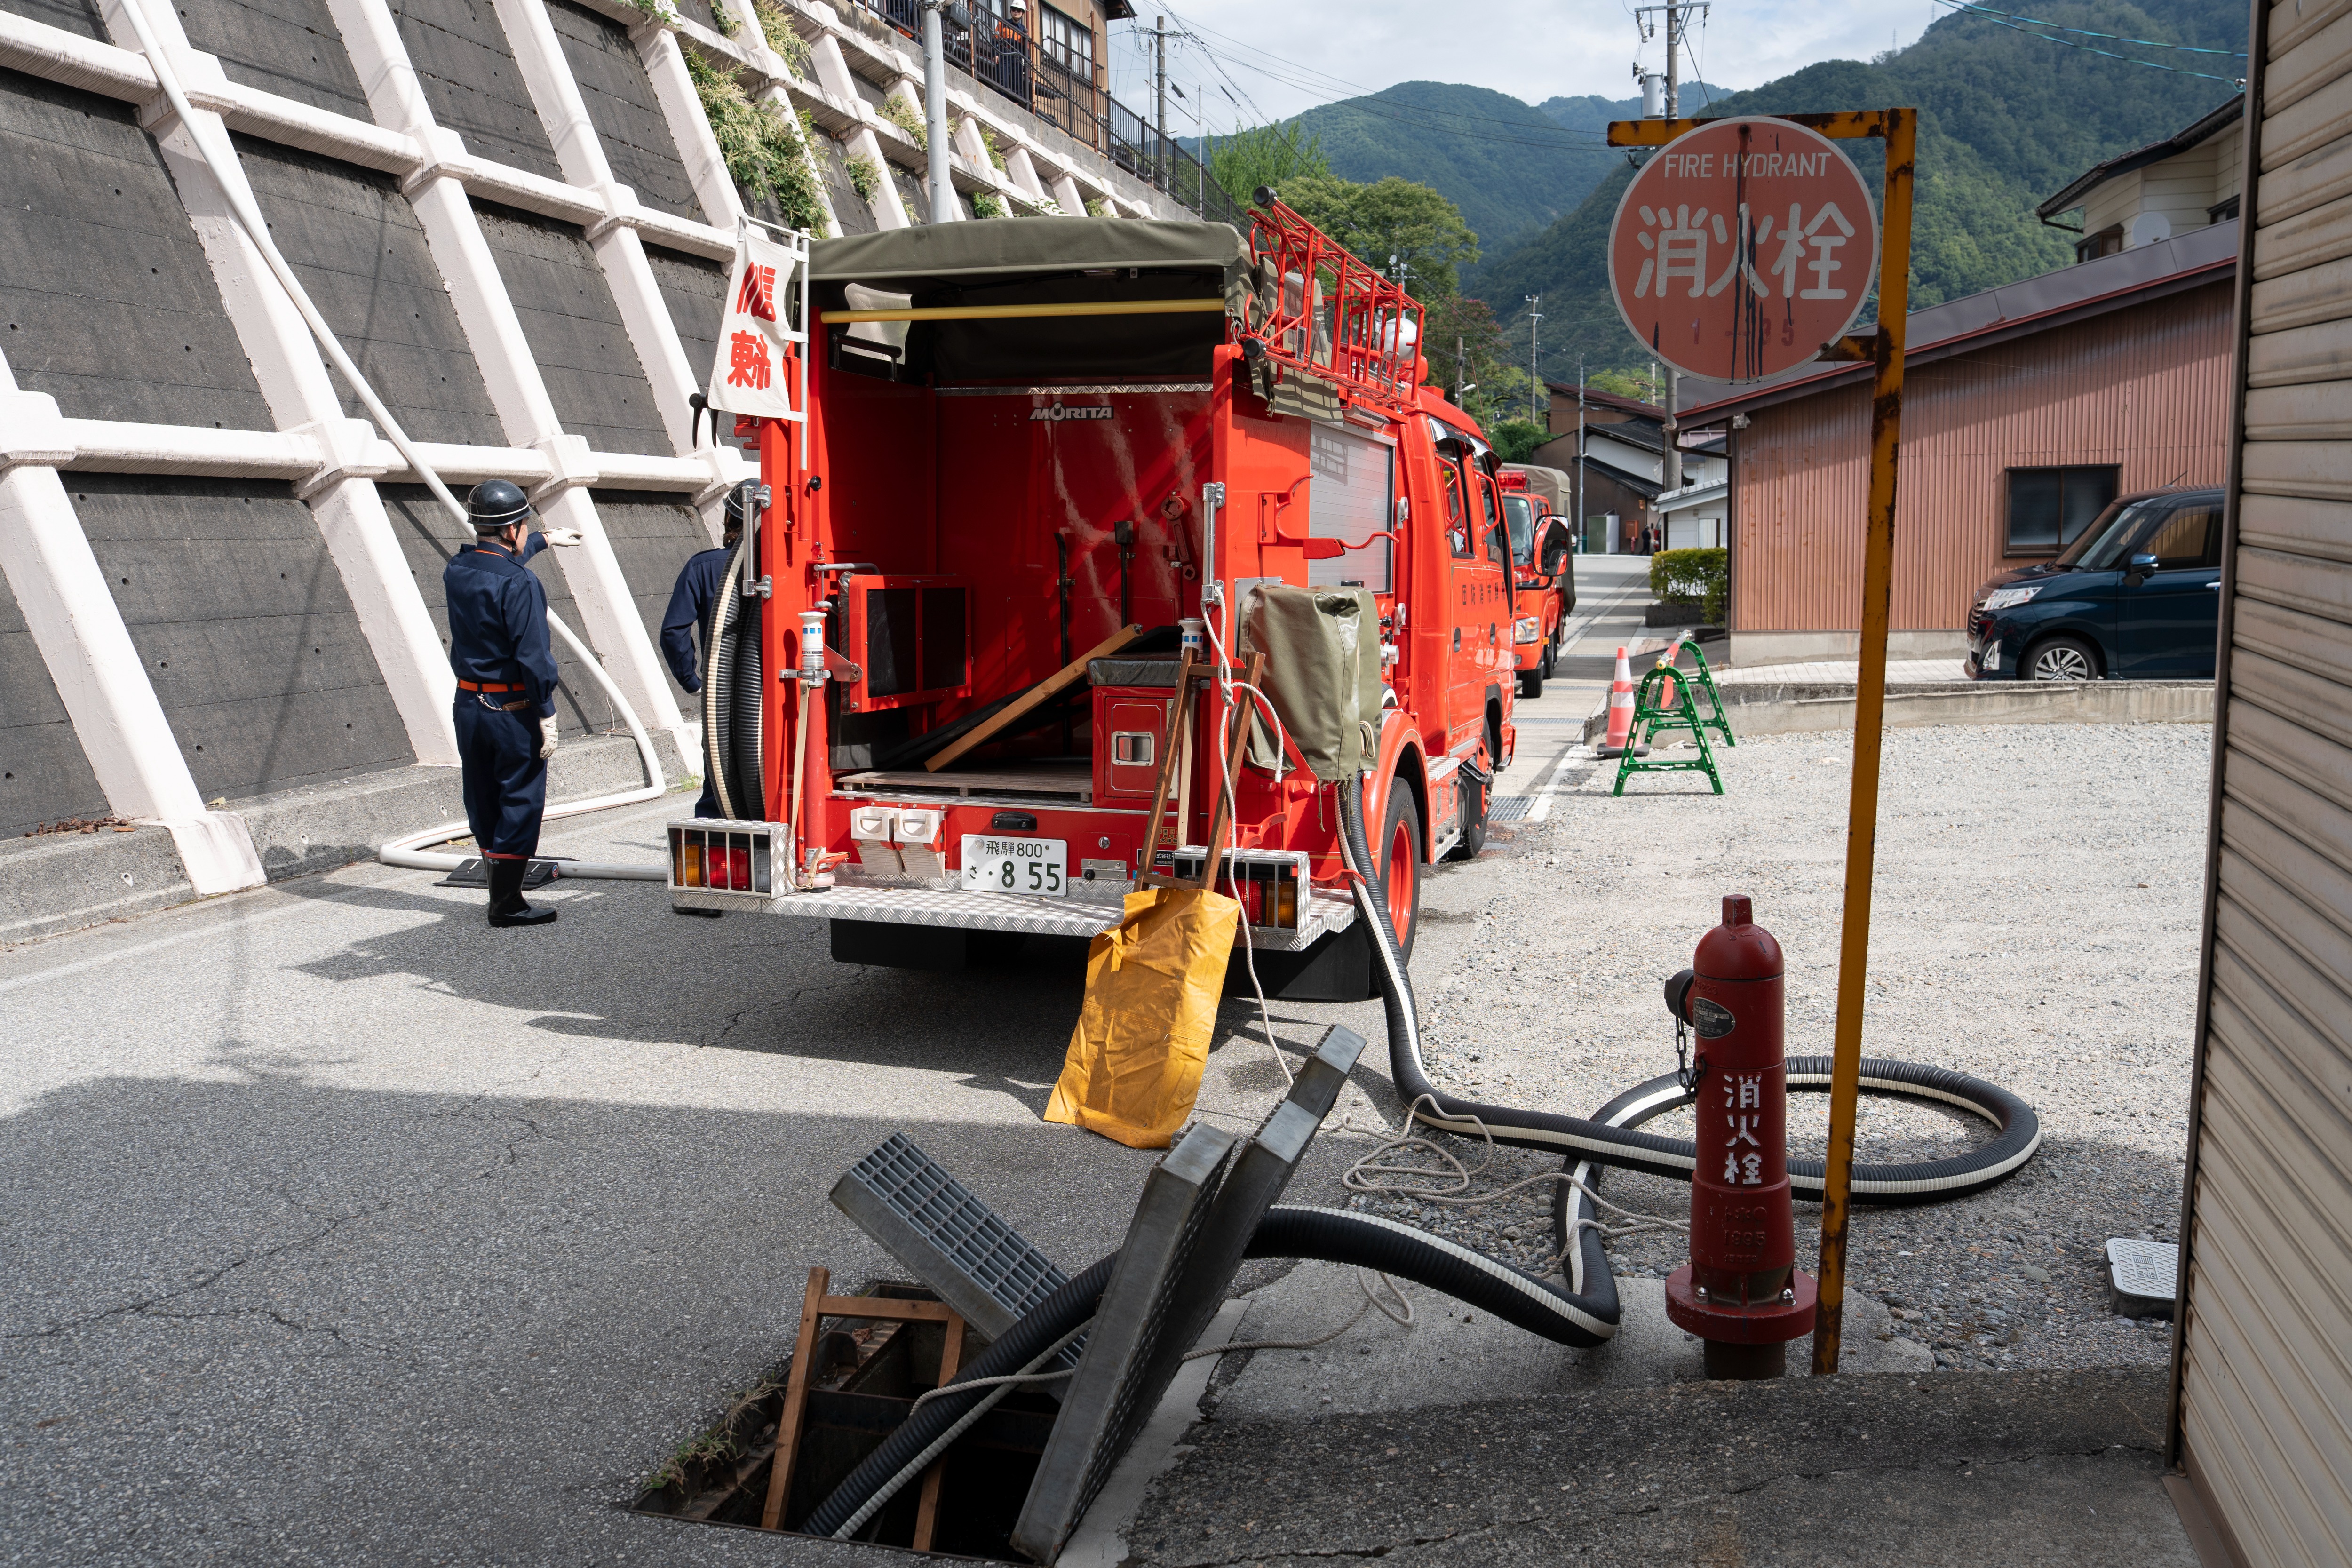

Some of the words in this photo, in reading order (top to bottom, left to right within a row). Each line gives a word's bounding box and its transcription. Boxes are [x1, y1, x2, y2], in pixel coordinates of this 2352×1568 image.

[1664, 153, 1714, 178] FIRE
[1723, 152, 1831, 177] HYDRANT
[1634, 201, 1855, 300] 消火栓
[1029, 402, 1112, 421] MORITA
[969, 865, 977, 879] さ
[1724, 1072, 1762, 1185] 消火栓
[1724, 1229, 1765, 1247] 1995
